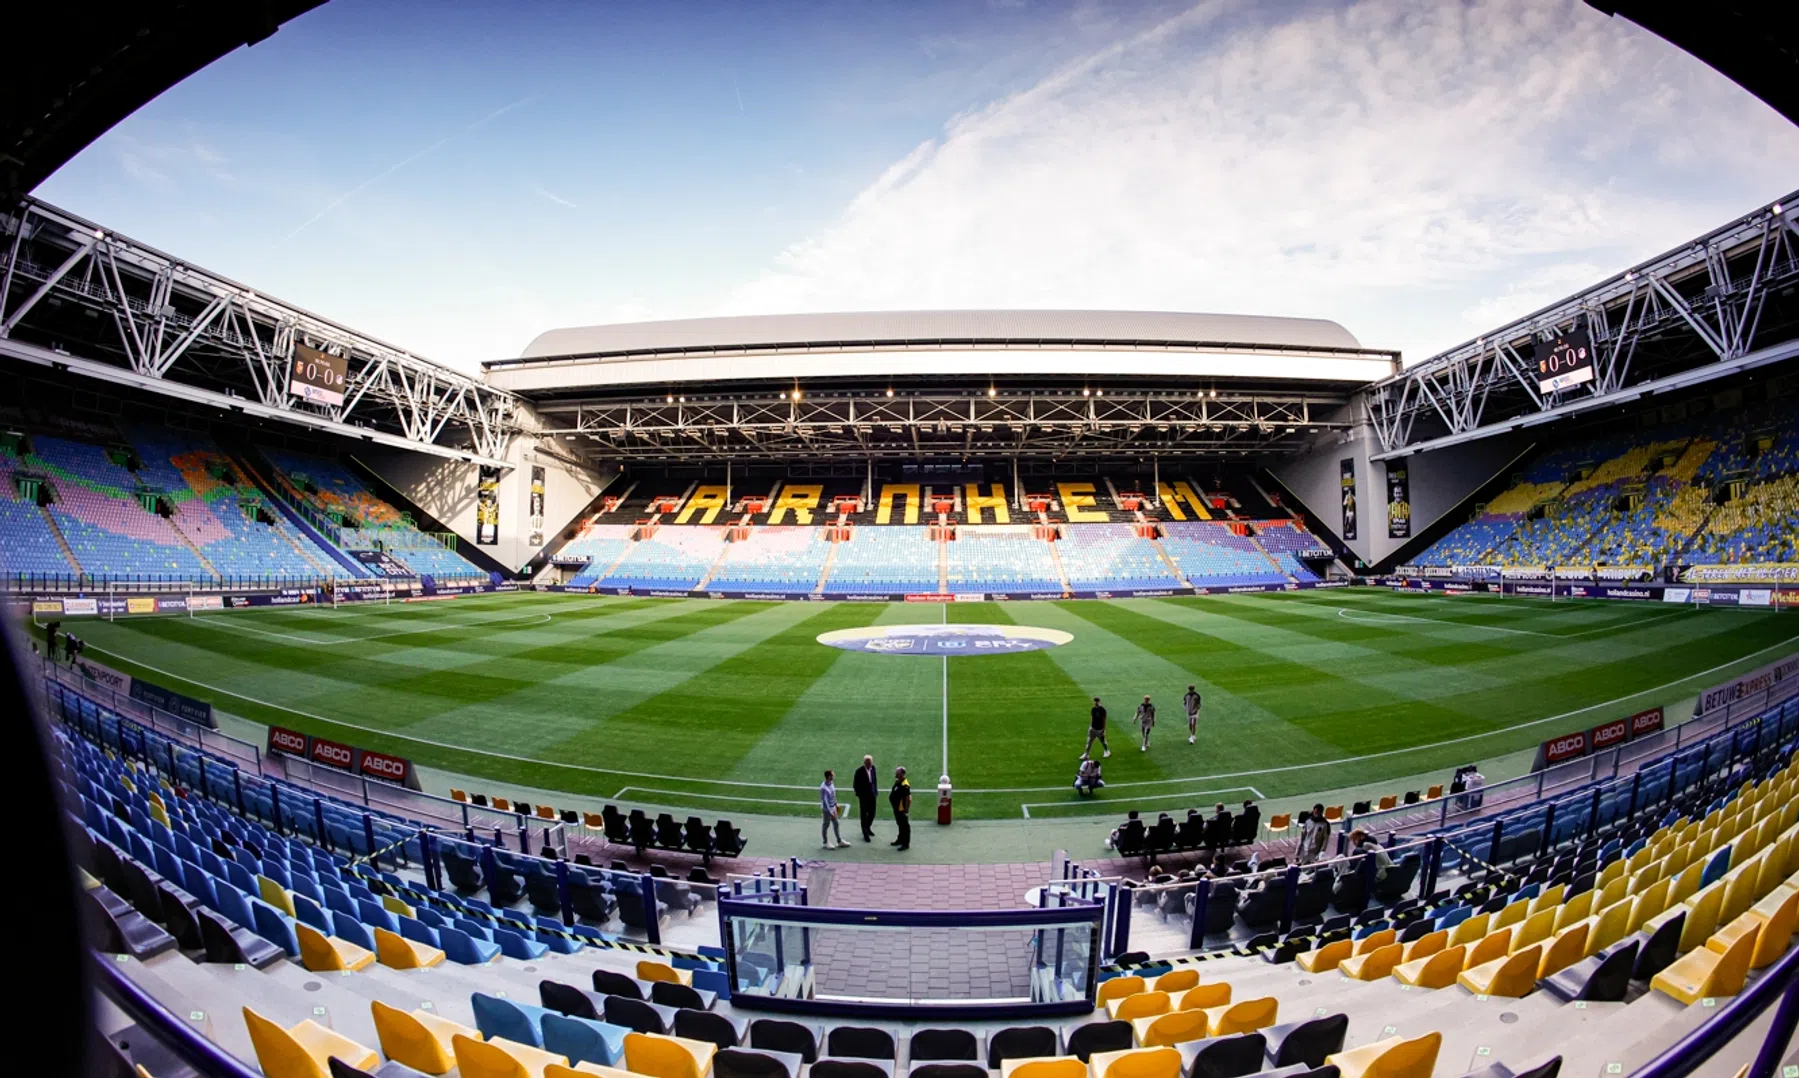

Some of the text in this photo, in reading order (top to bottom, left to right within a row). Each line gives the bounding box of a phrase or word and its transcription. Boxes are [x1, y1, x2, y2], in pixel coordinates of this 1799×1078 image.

[1607, 589, 1650, 597] hollandcasino.nl
[89, 665, 124, 689] TENPOORT
[1634, 712, 1660, 729] ABCO
[273, 731, 304, 749] ABCO
[1594, 724, 1625, 744] ABCO
[315, 743, 350, 763] ABCO
[1548, 736, 1584, 756] ABCO
[363, 756, 403, 775] ABCO
